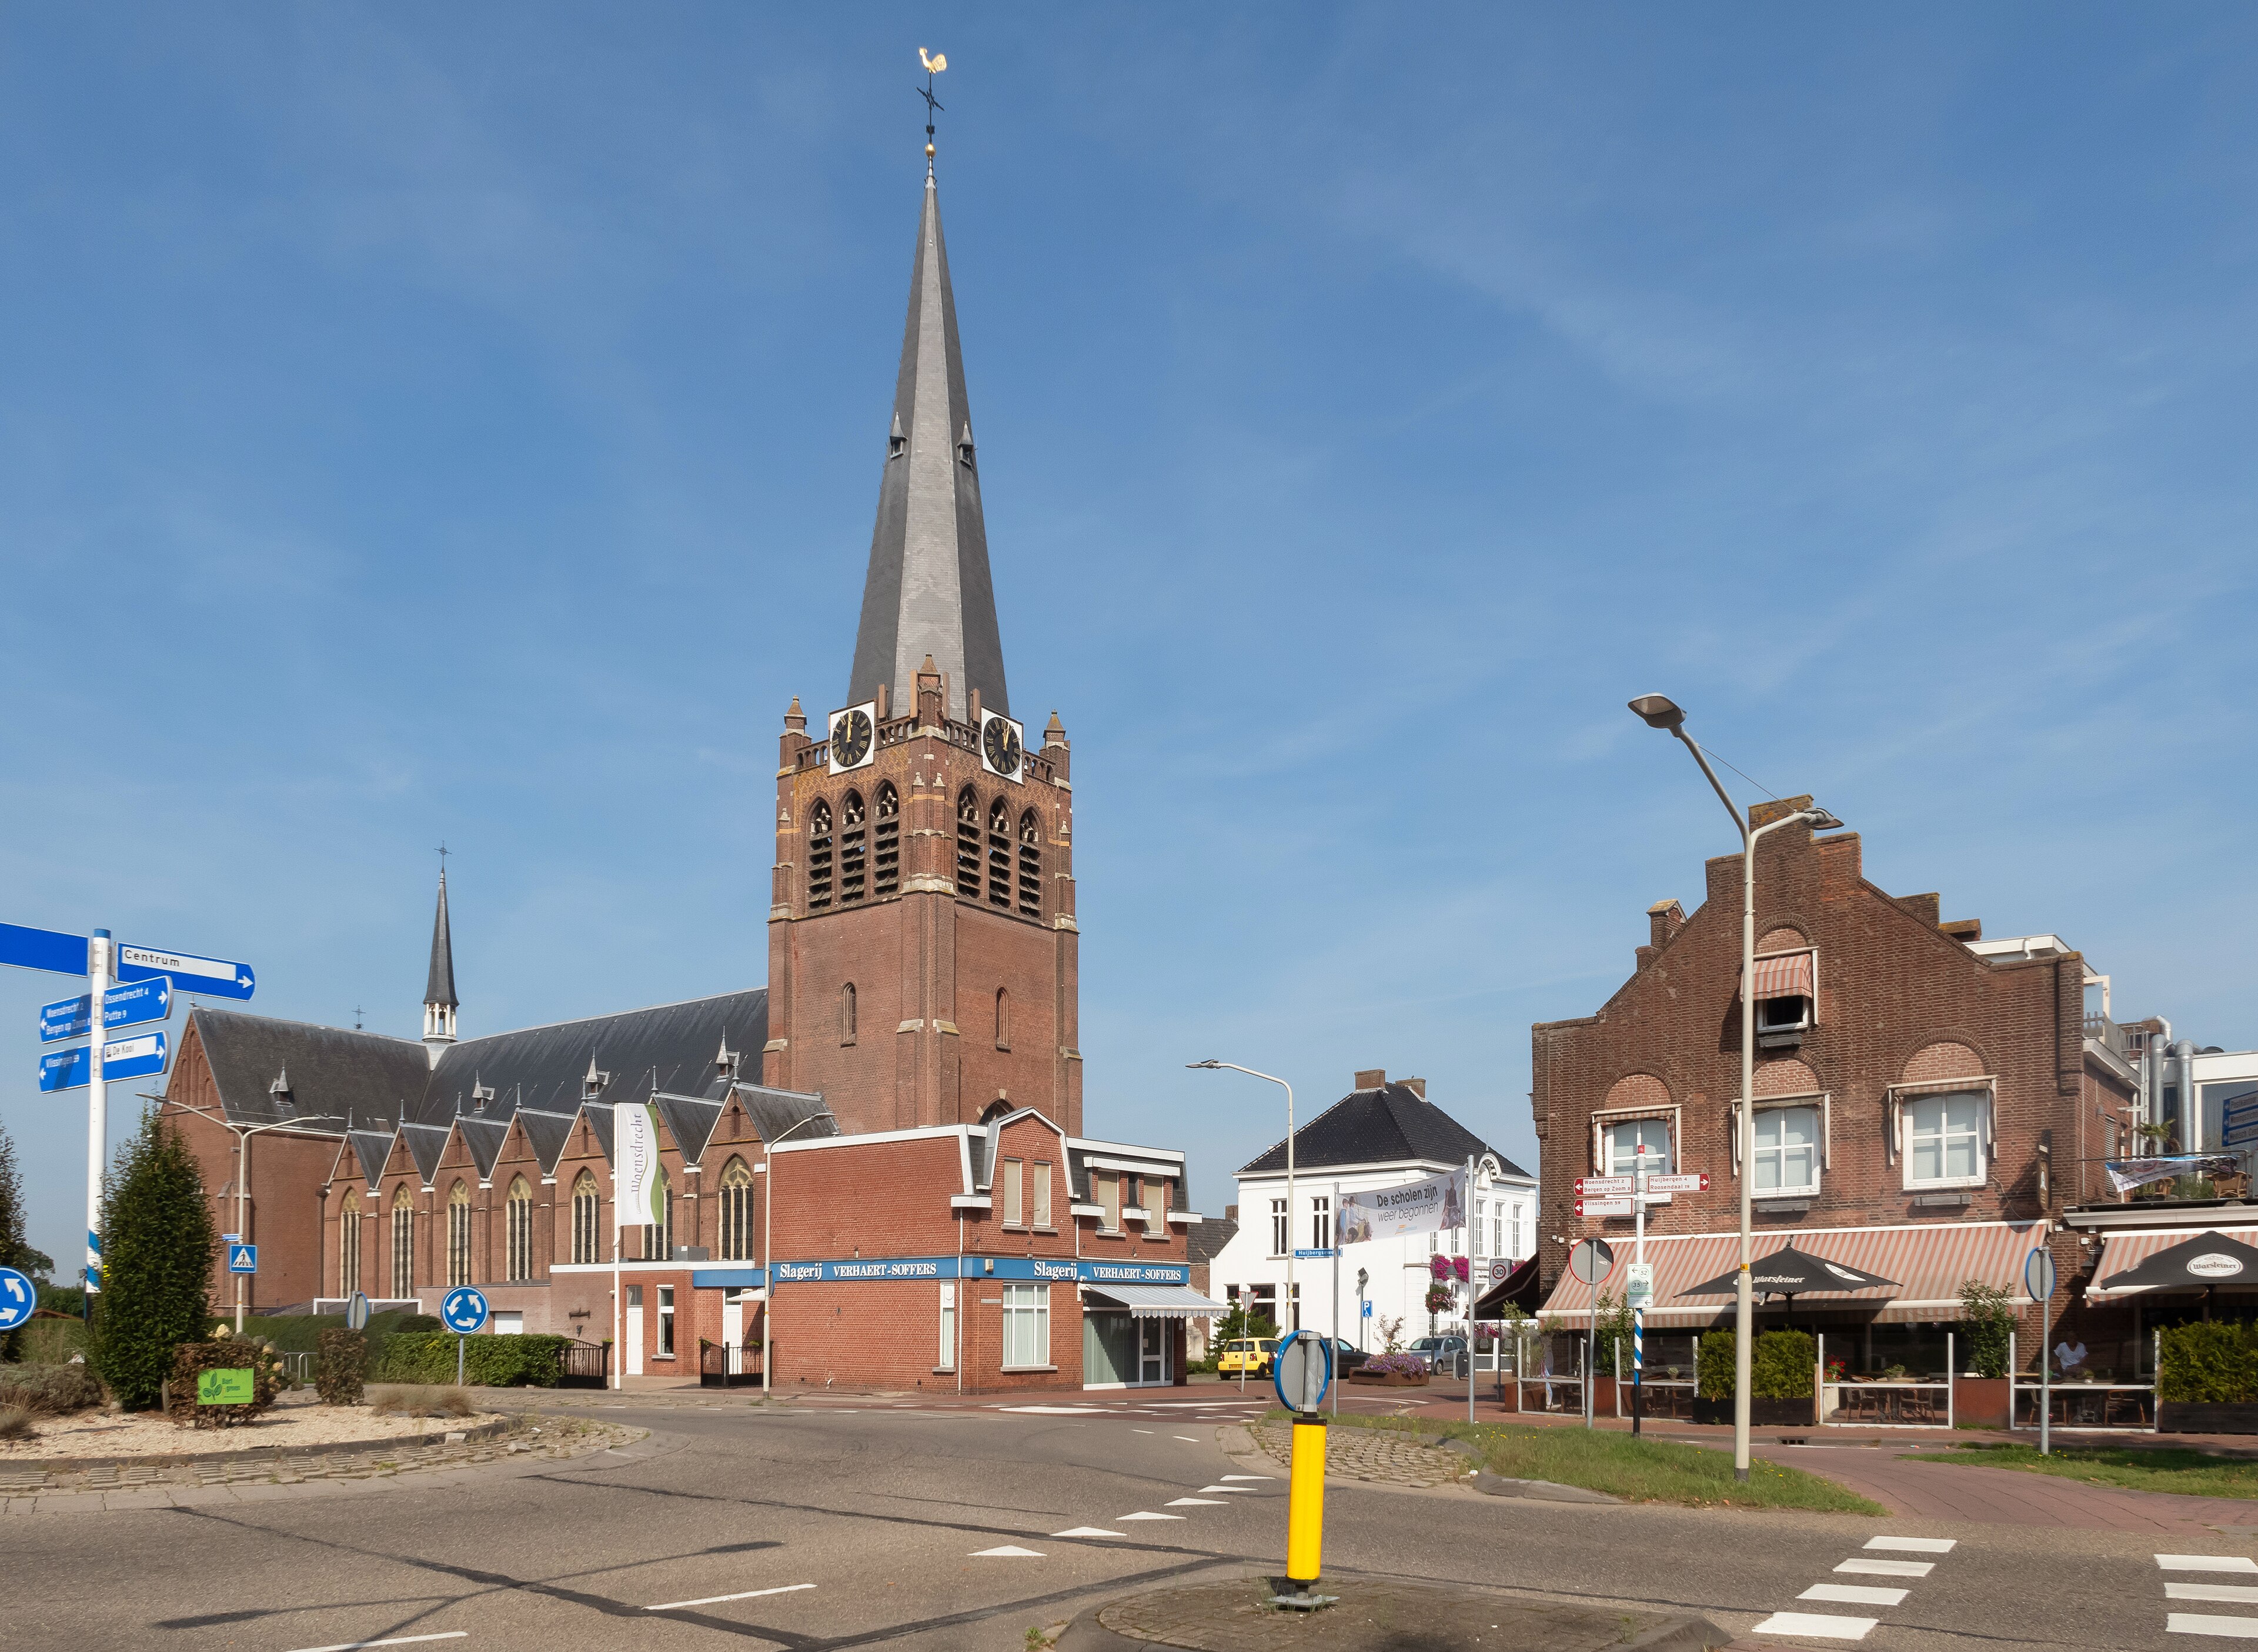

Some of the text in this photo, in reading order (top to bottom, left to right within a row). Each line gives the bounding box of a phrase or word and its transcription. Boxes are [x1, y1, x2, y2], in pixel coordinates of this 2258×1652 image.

[125, 949, 179, 967] Centrum
[105, 988, 143, 1004] Ossendrecht
[105, 1011, 122, 1022] Putte
[113, 1046, 120, 1055] De
[630, 1113, 644, 1193] Woensdrecht
[1377, 1185, 1438, 1207] De scholen zijn
[1378, 1202, 1438, 1222] weer begonnen
[780, 1263, 822, 1280] Slagerij
[1034, 1262, 1077, 1280] Slagerij
[1752, 1275, 1805, 1284] Warsteiner
[1364, 1302, 1370, 1310] P
